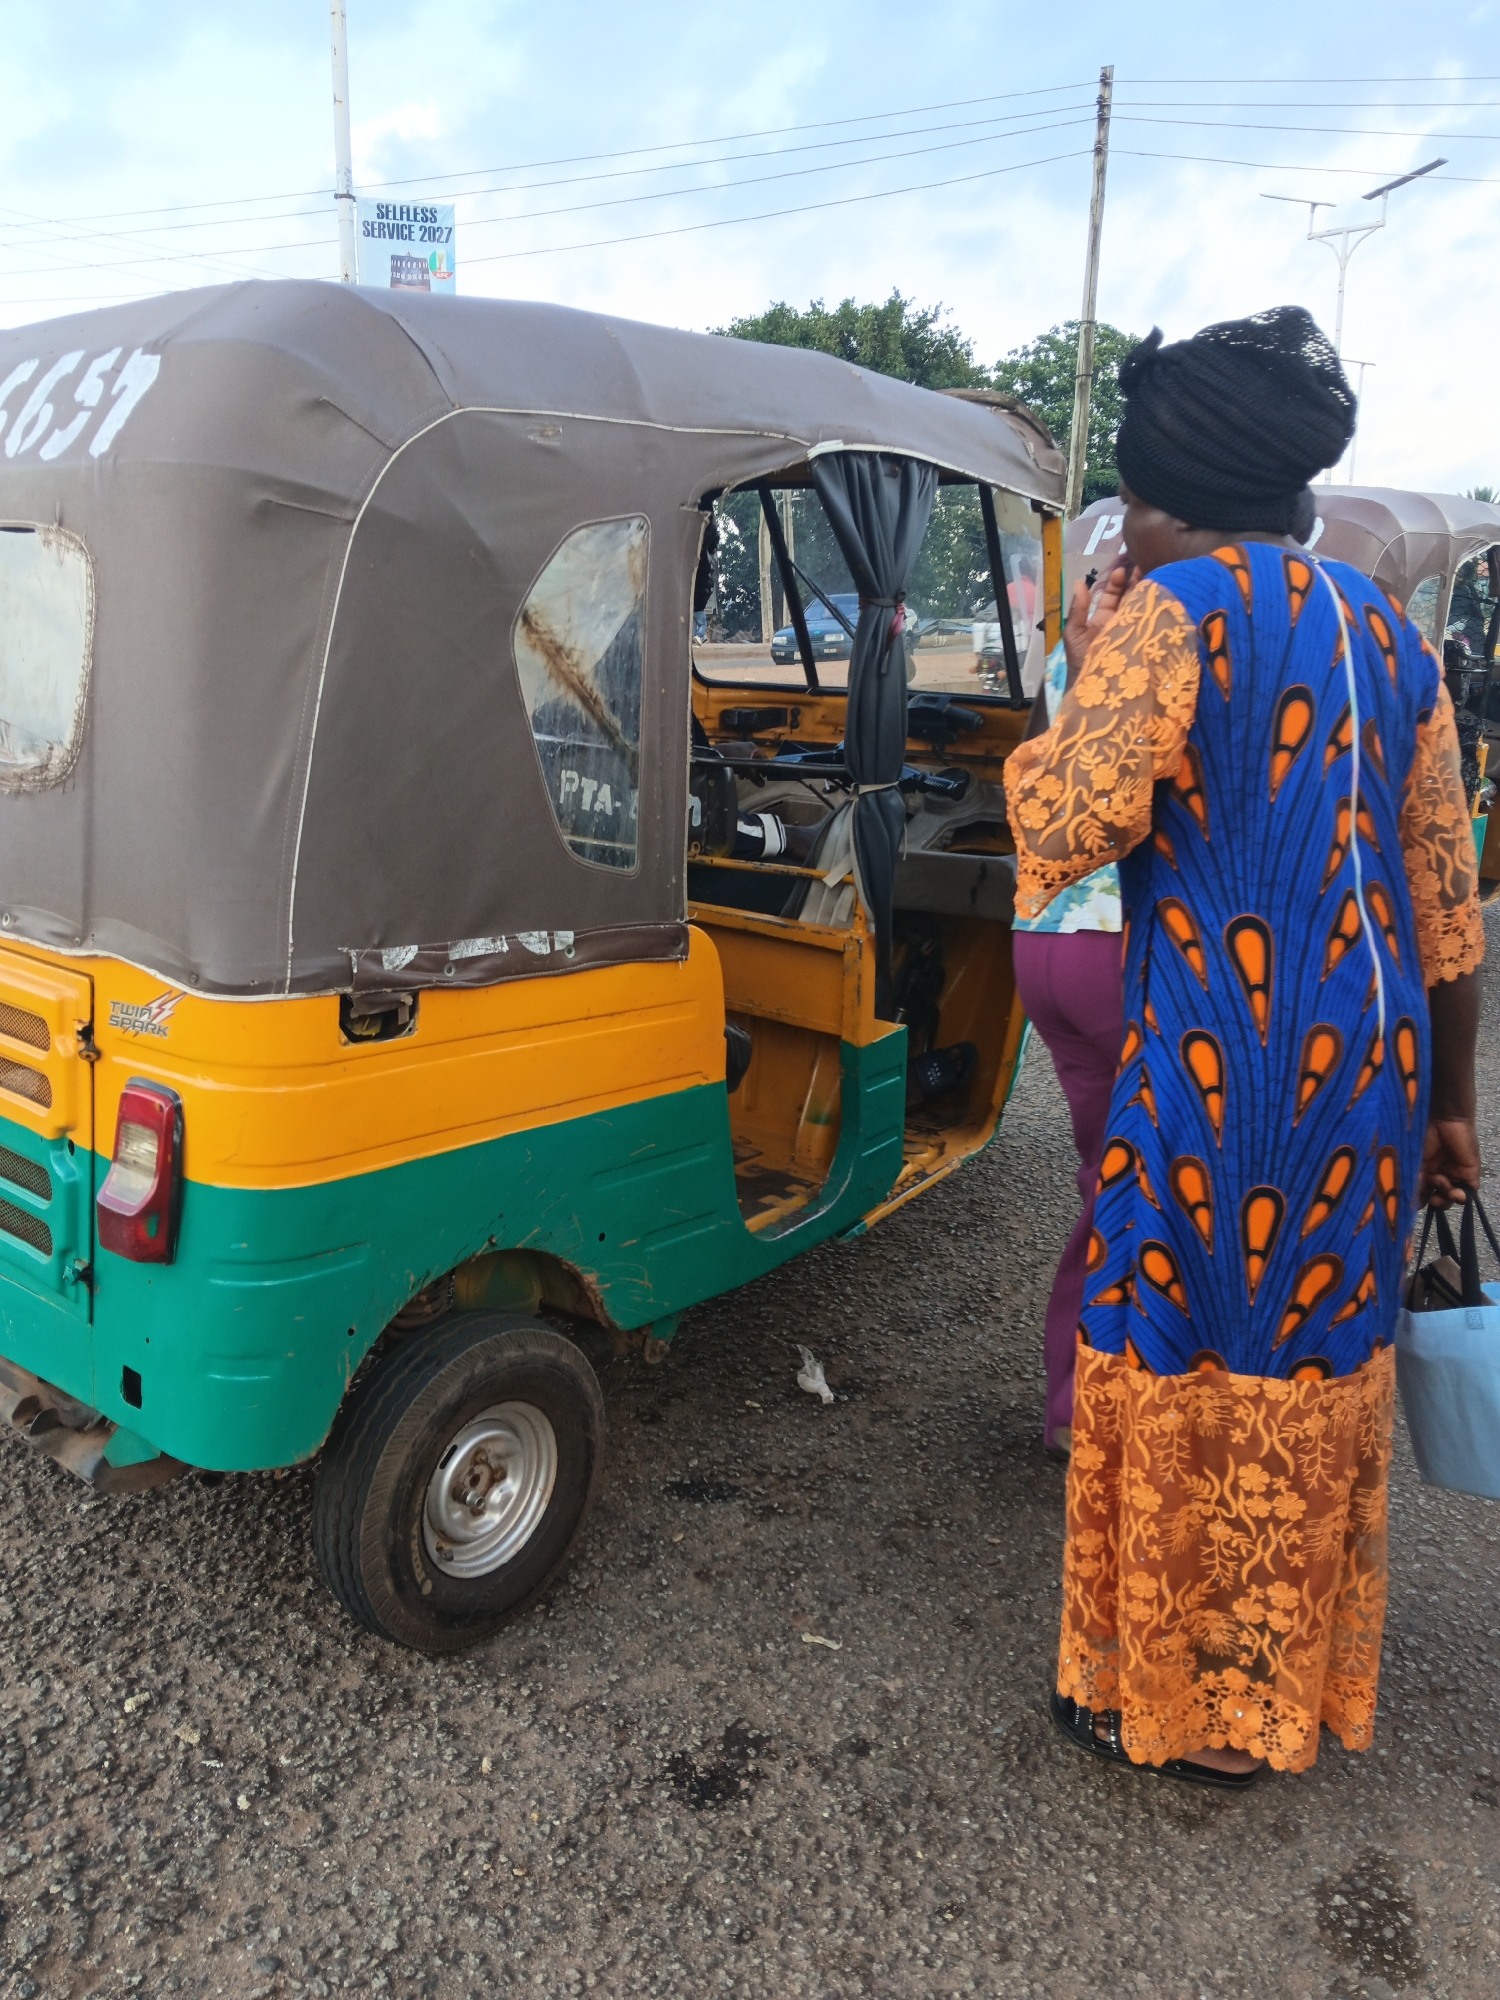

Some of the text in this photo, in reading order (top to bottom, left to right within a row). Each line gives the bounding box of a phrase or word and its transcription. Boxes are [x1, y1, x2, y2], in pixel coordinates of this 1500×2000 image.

[376, 203, 438, 223] SELFLESS
[362, 220, 452, 243] SERVICE 2027
[109, 1000, 152, 1020] TWIN
[108, 1015, 168, 1037] SPARK
